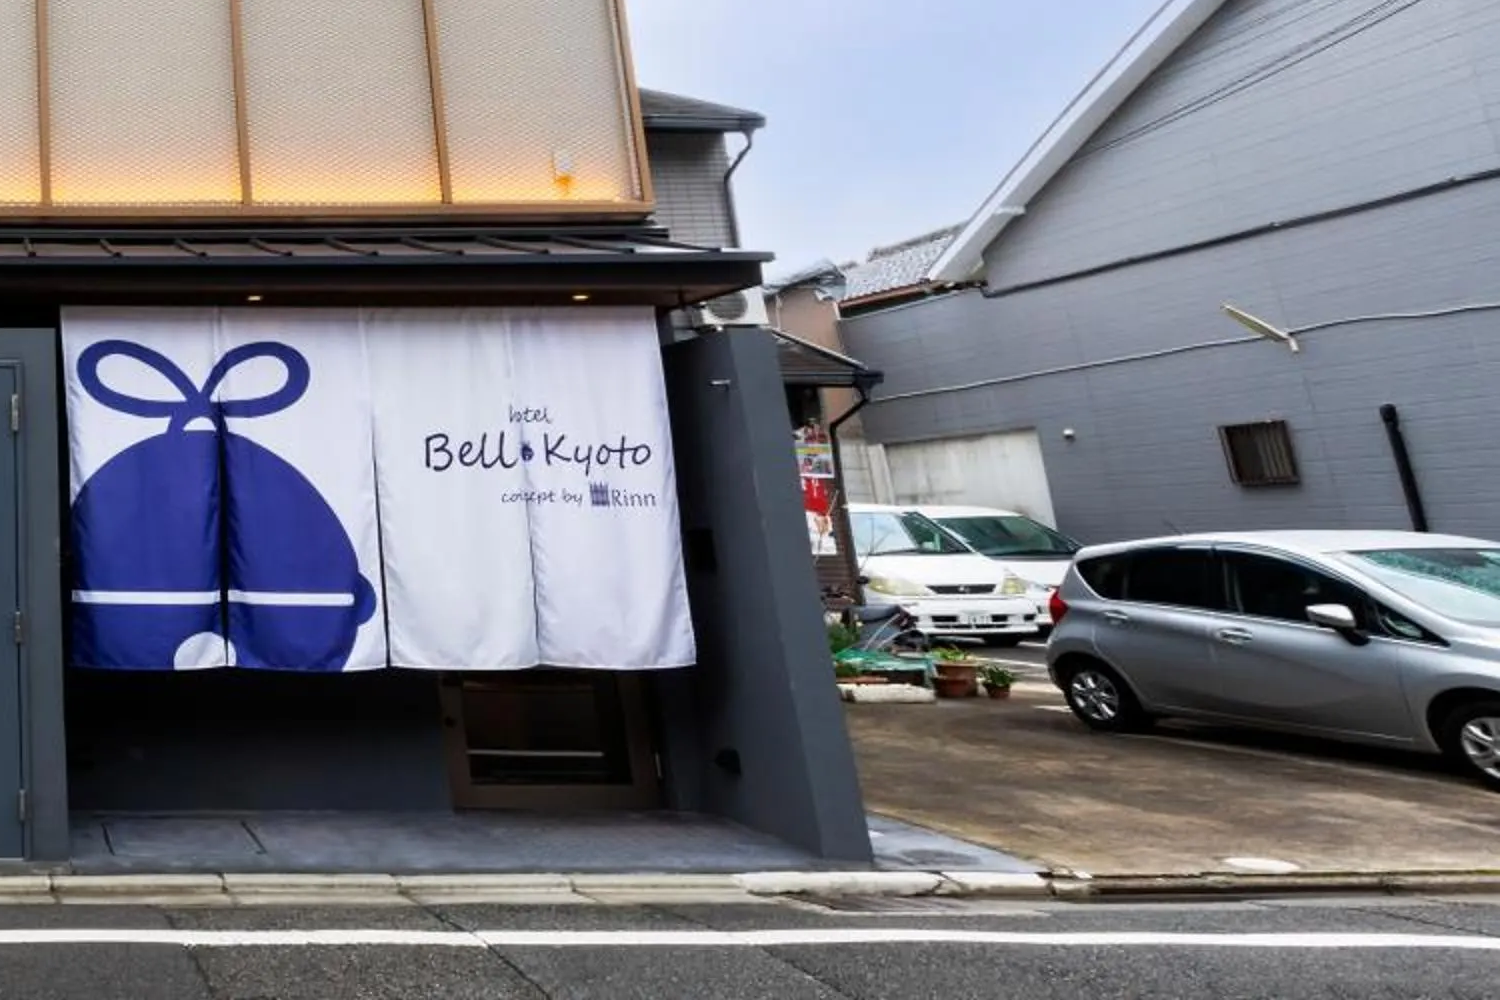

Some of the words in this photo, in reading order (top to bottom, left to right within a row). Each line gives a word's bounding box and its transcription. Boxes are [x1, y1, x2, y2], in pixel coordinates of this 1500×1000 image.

[424, 431, 518, 471] Bell
[543, 433, 652, 476] Kyoto
[562, 488, 583, 507] by
[611, 488, 657, 507] Rinn
